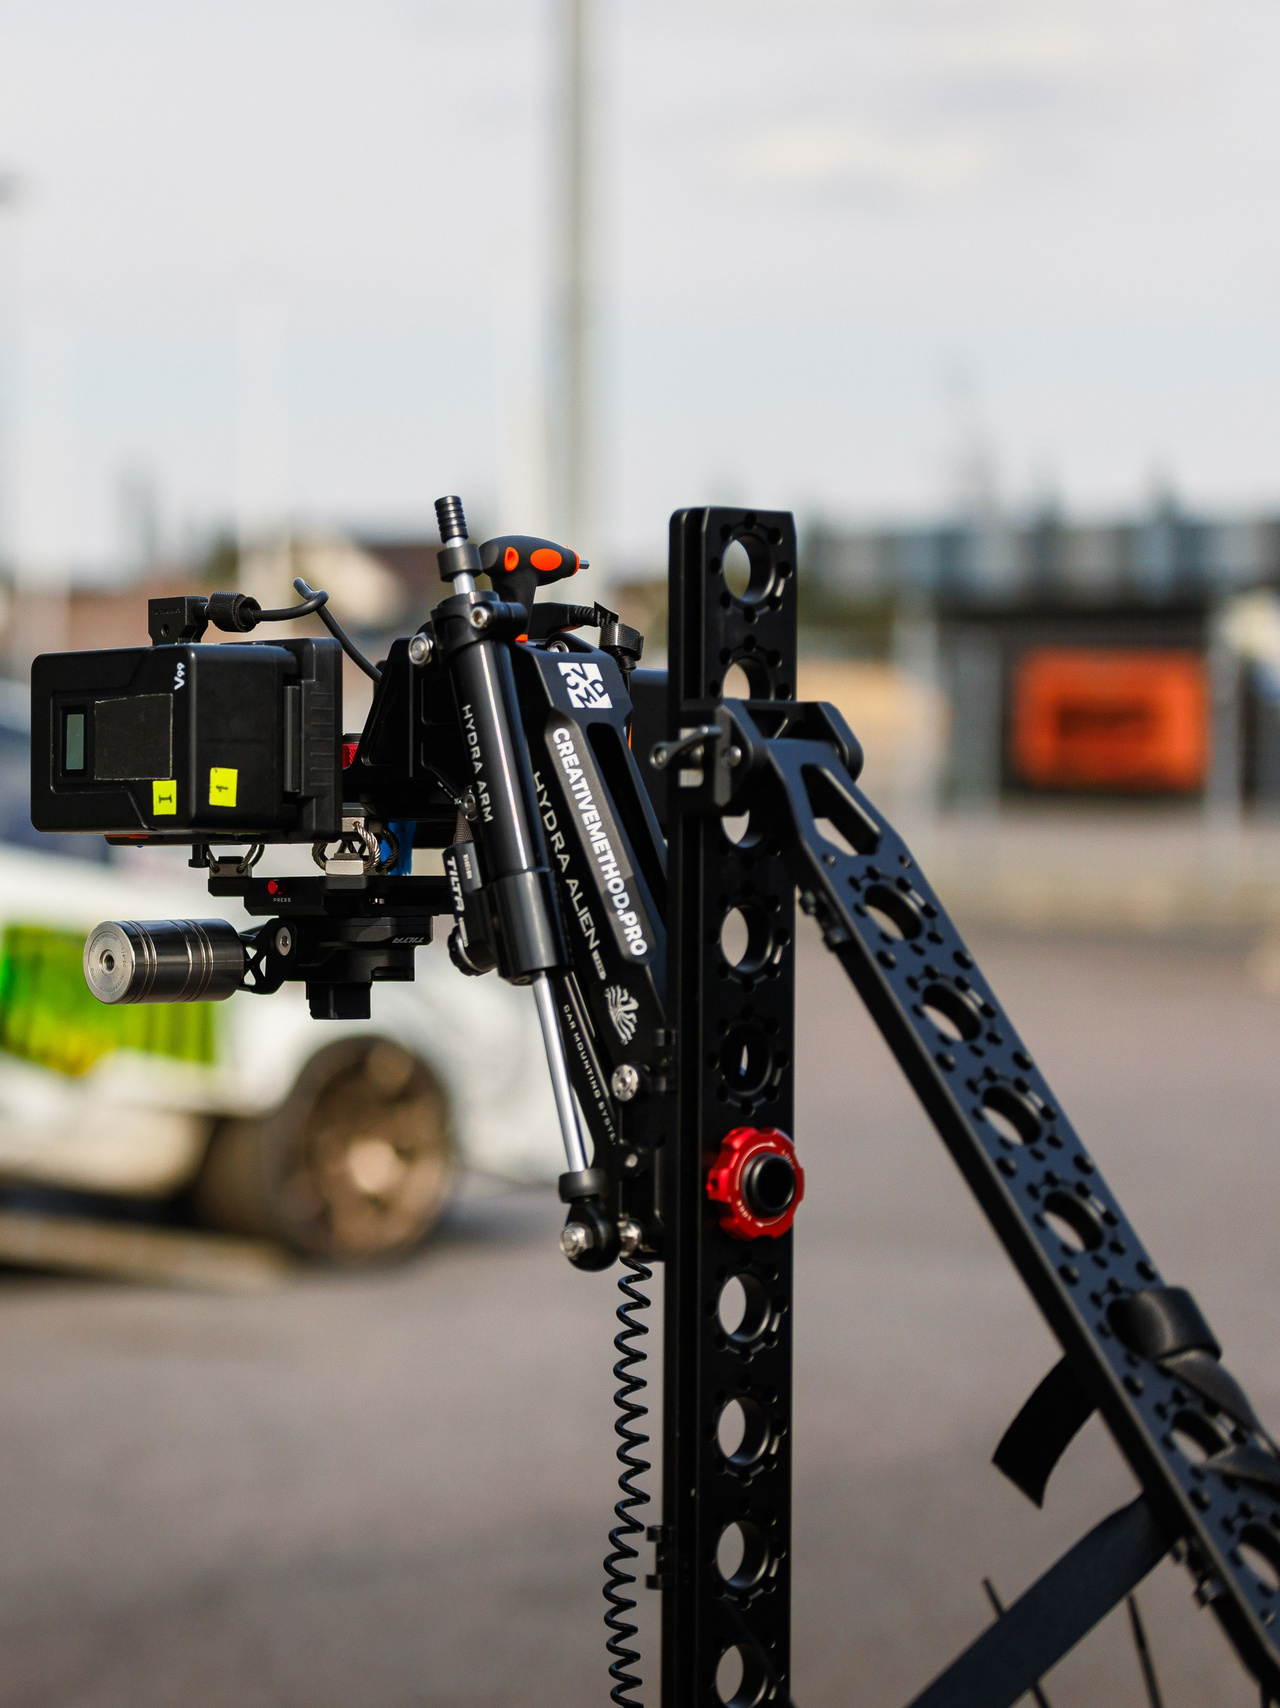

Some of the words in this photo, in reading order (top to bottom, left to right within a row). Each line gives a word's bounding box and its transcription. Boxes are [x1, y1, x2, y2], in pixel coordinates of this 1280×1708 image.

[173, 662, 186, 690] V99
[462, 704, 483, 774] HYDRA
[477, 780, 494, 822] ARM
[447, 856, 465, 911] TILTA
[533, 771, 570, 873] HYDRA
[566, 878, 600, 950] ALIEN
[552, 727, 648, 956] CREATIVEMETHOD.PRO
[563, 1004, 577, 1030] CAR
[573, 1032, 601, 1099] MOUNTING
[598, 1101, 617, 1145] SYSTE
